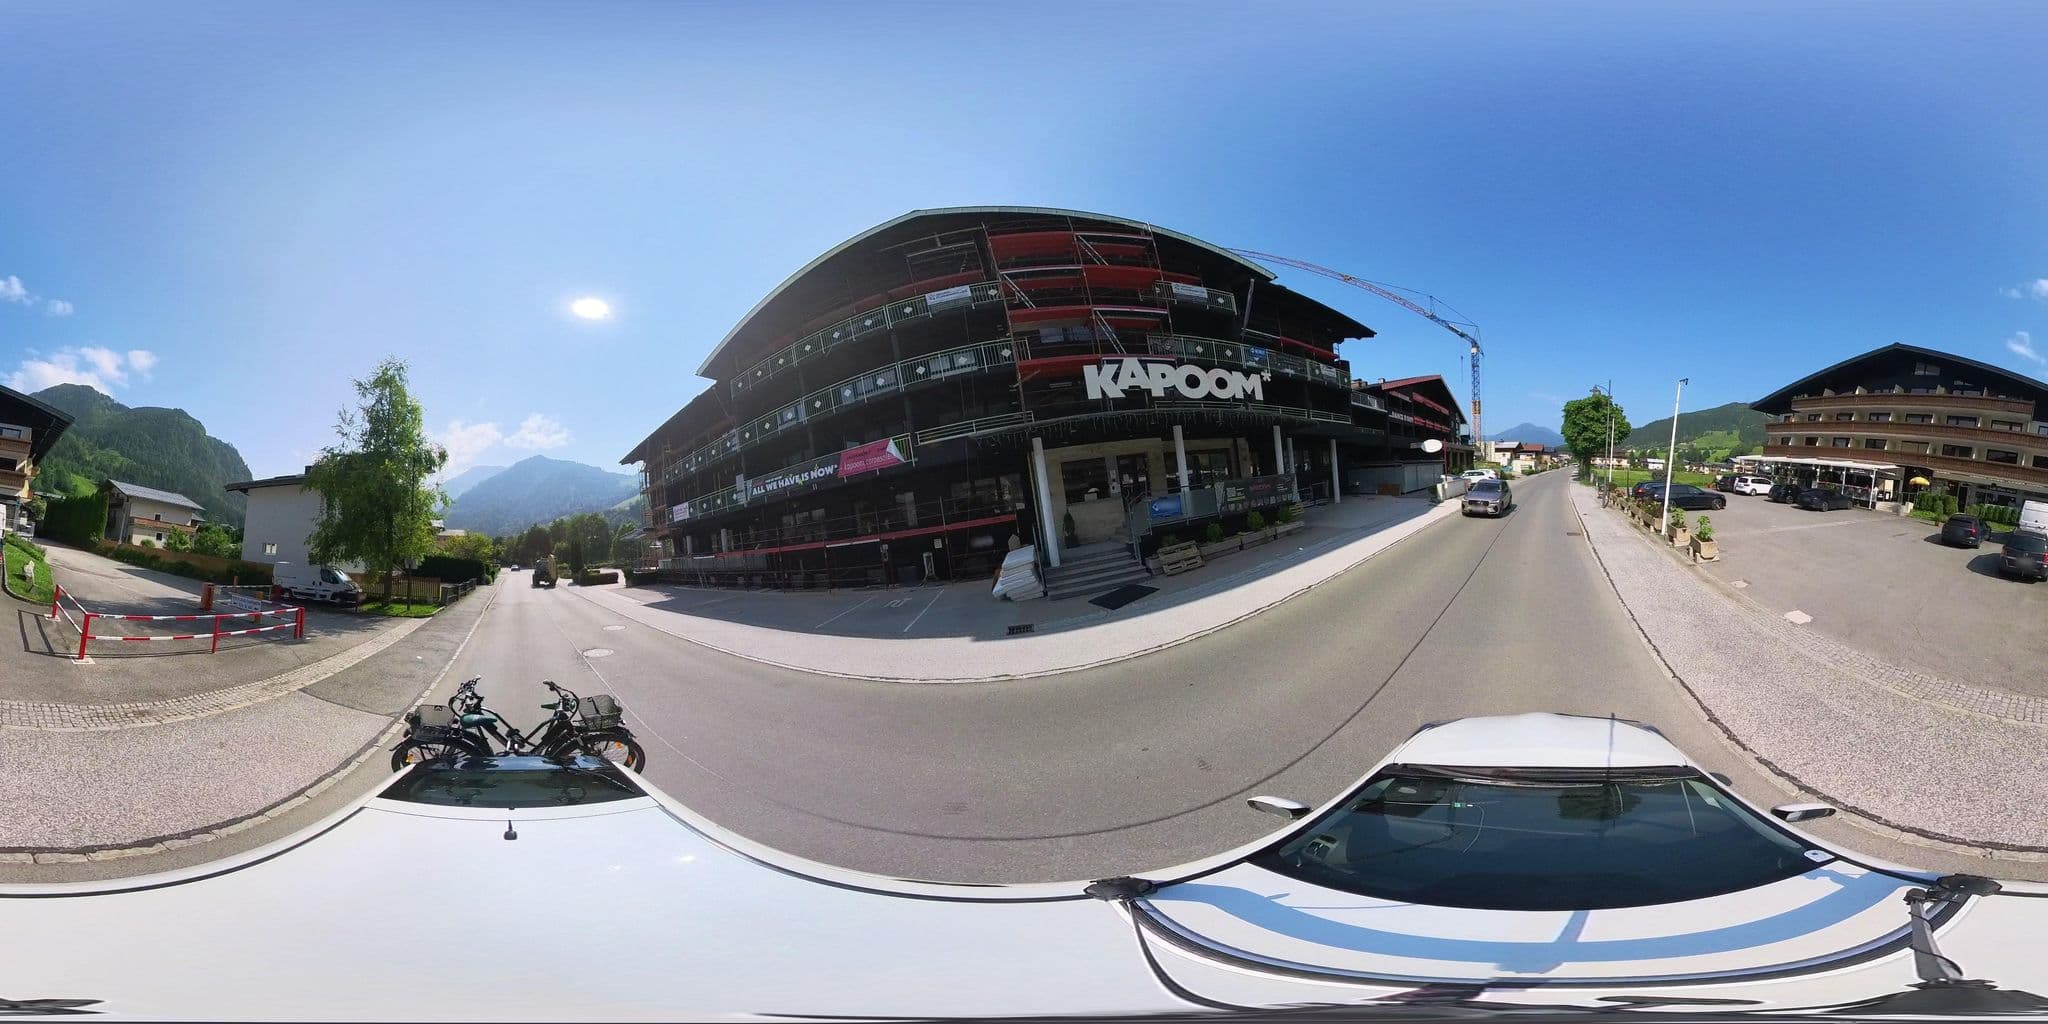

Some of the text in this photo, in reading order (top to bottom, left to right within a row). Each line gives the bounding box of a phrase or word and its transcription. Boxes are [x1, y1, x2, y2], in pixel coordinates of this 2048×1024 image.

[753, 486, 765, 496] ALL
[766, 482, 778, 492] WE
[779, 475, 800, 487] HAVE
[801, 472, 809, 481] IS
